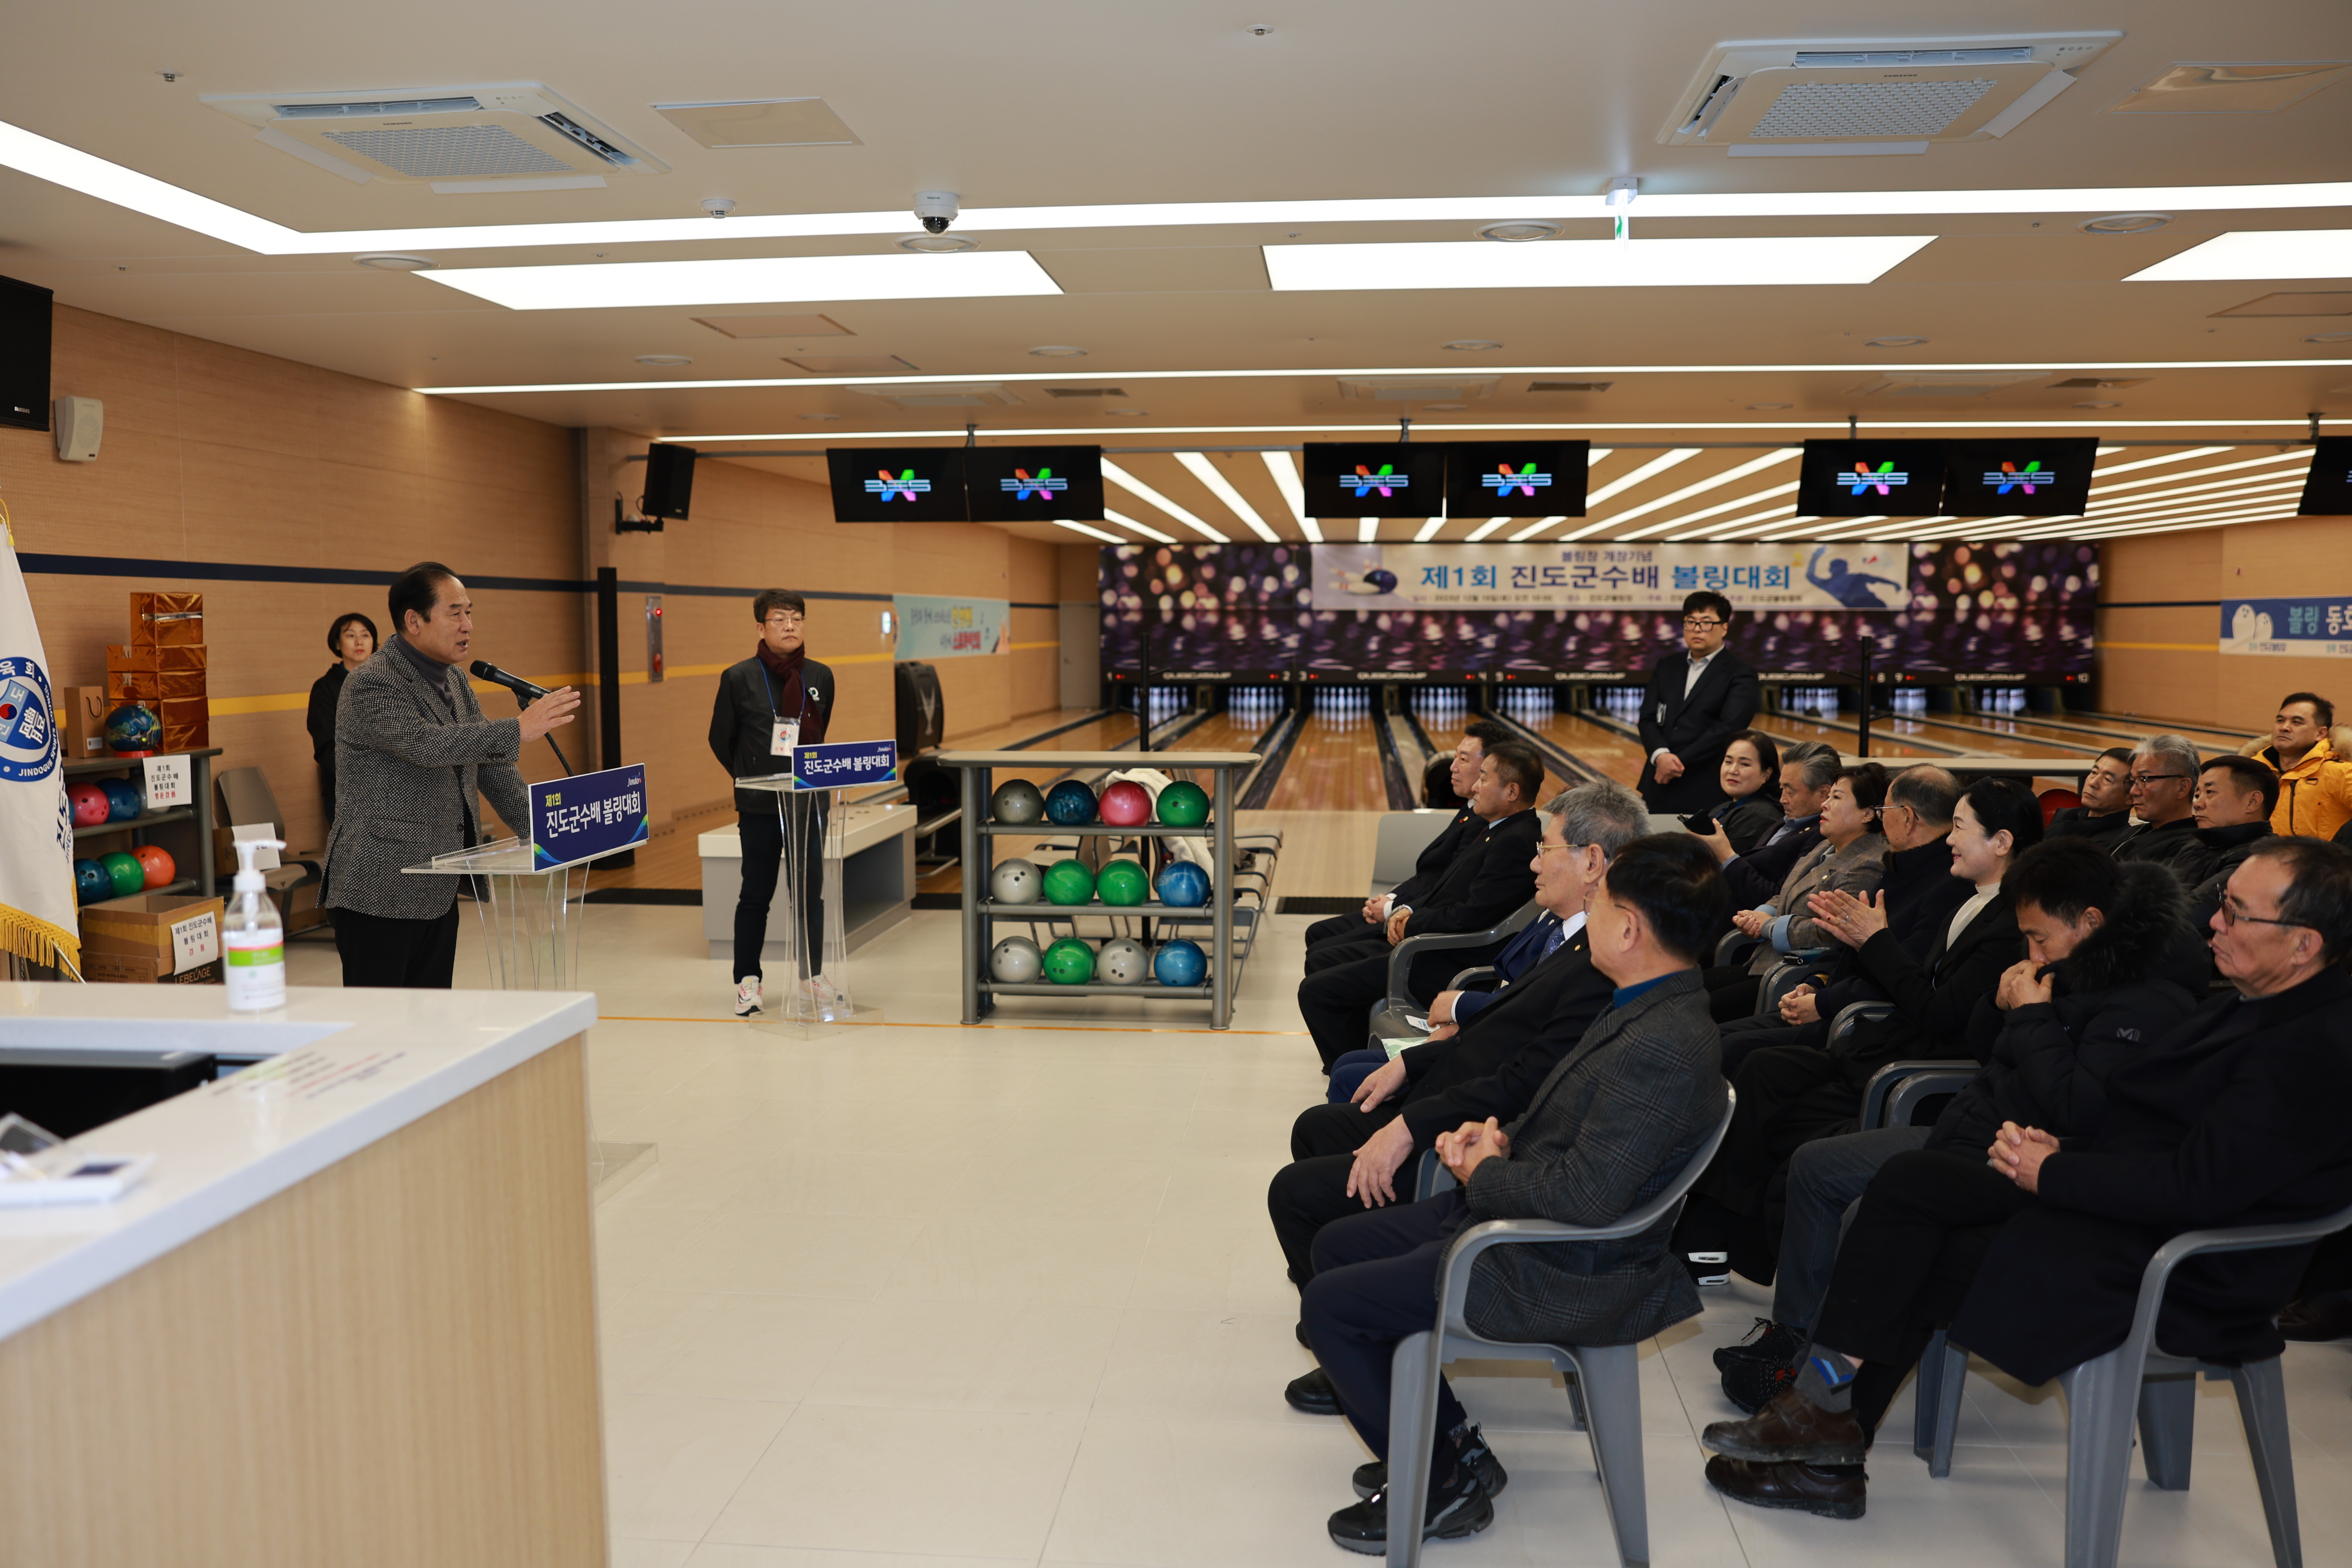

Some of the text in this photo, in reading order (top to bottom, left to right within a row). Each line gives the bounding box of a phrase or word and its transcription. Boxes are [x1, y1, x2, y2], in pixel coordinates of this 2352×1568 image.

[1421, 565, 1790, 589] 제1회 진도군수배 볼링대회
[2288, 606, 2319, 635] 볼링
[1107, 671, 1112, 681] 1
[1282, 671, 1290, 681] 2
[1299, 671, 1307, 681] 3
[1478, 671, 1487, 681] 4
[2078, 673, 2090, 683] 10
[18, 759, 53, 777] JINDOGUN
[804, 754, 889, 775] 진도군수배 볼링대회
[151, 773, 179, 782] 진도군수배
[154, 782, 176, 791] 볼링대회
[545, 792, 561, 807] 제1회
[546, 791, 641, 838] 진도군수배 볼링대회
[175, 916, 212, 935] 제1회 진도군수배
